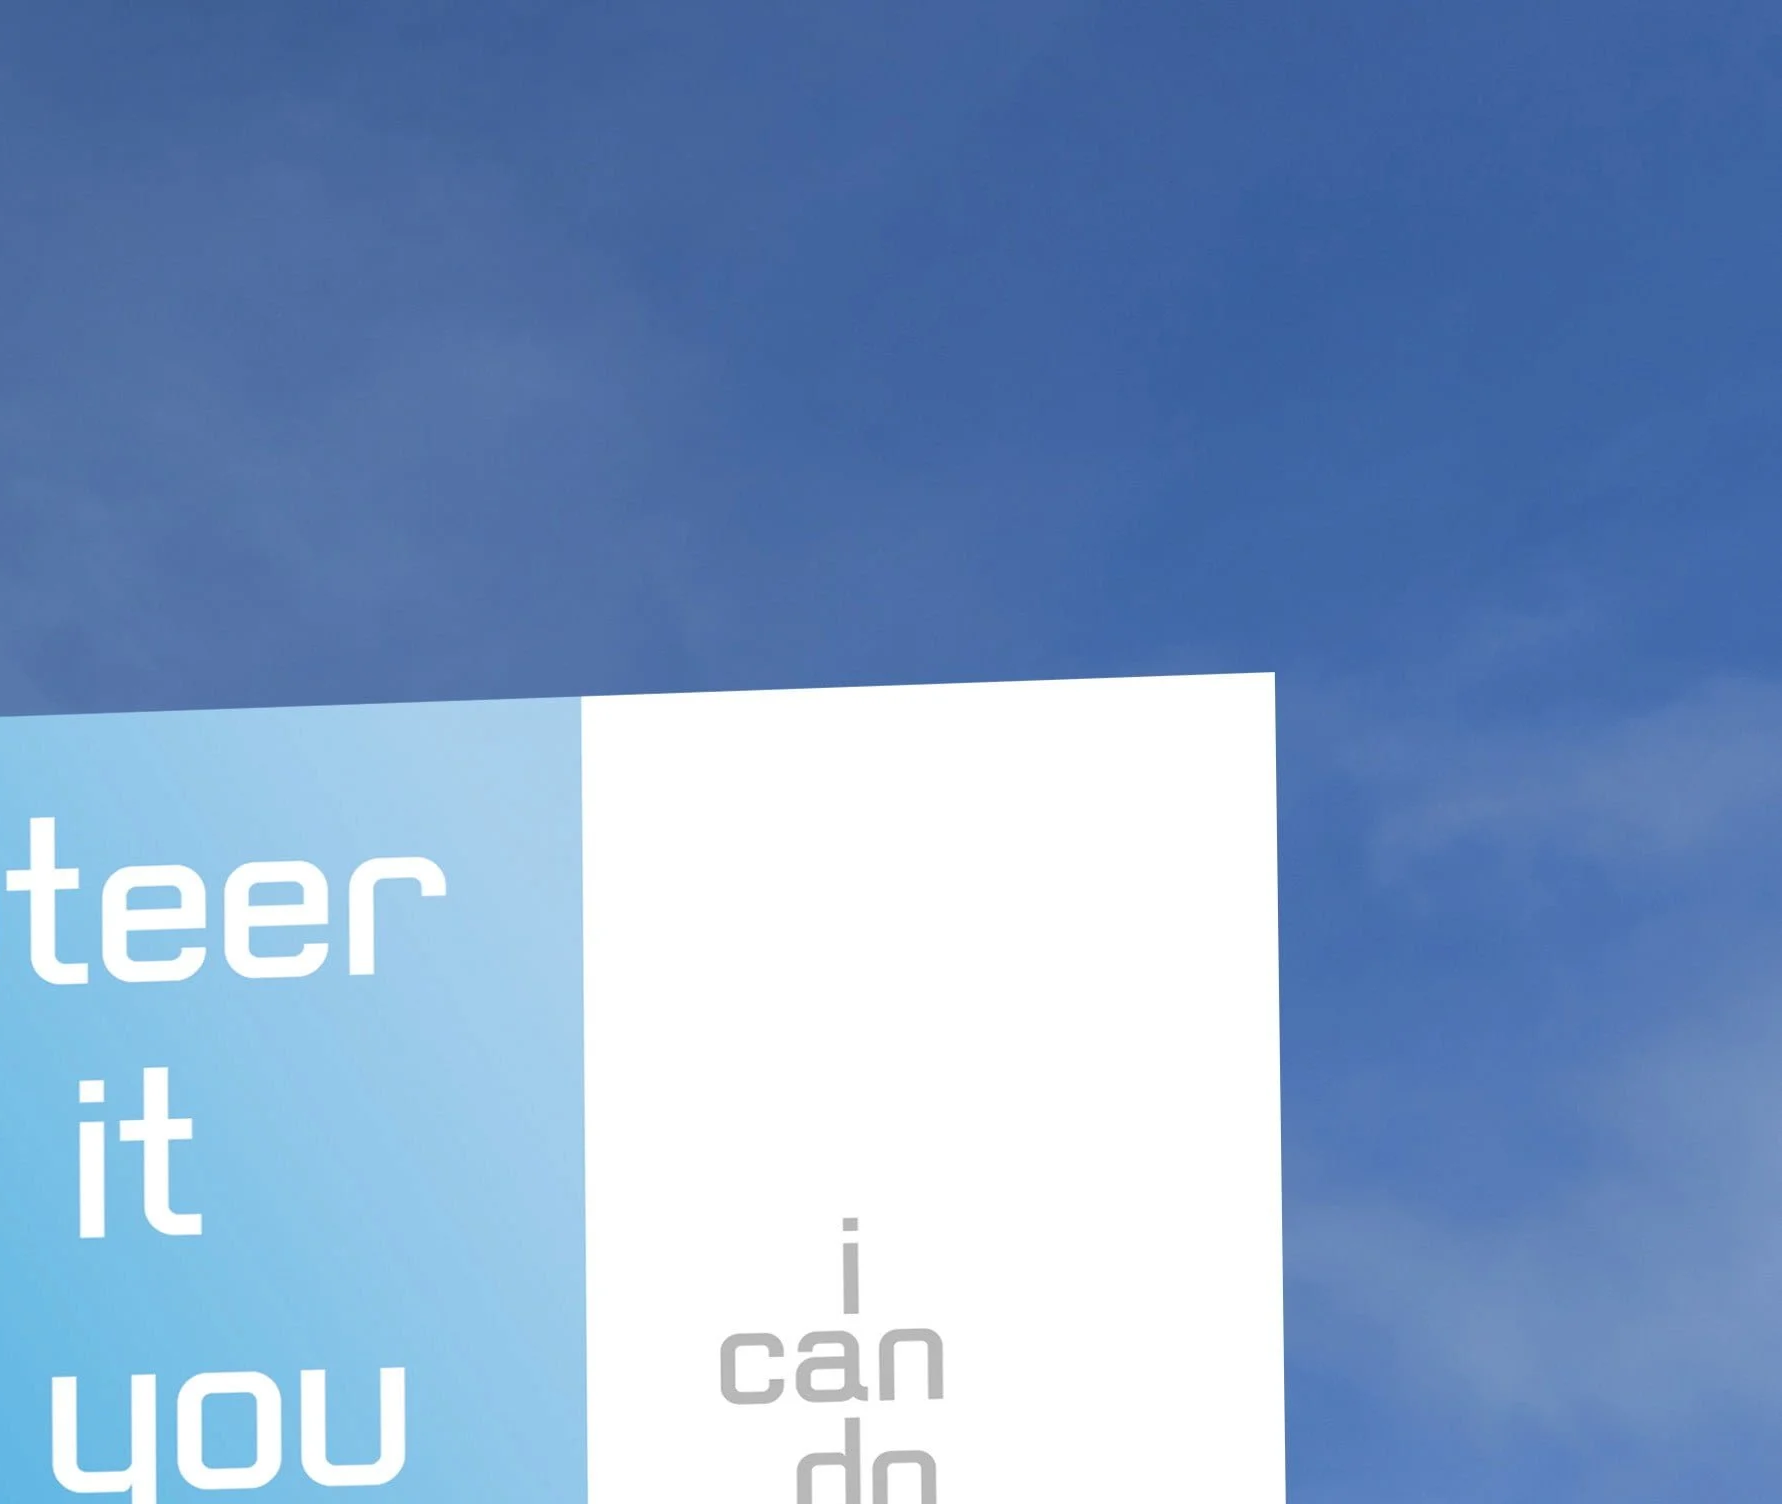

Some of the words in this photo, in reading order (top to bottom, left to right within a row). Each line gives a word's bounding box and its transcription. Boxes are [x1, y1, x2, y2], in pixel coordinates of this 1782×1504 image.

[77, 1066, 202, 1239] it
[842, 1217, 860, 1315] i
[720, 1328, 944, 1405] can
